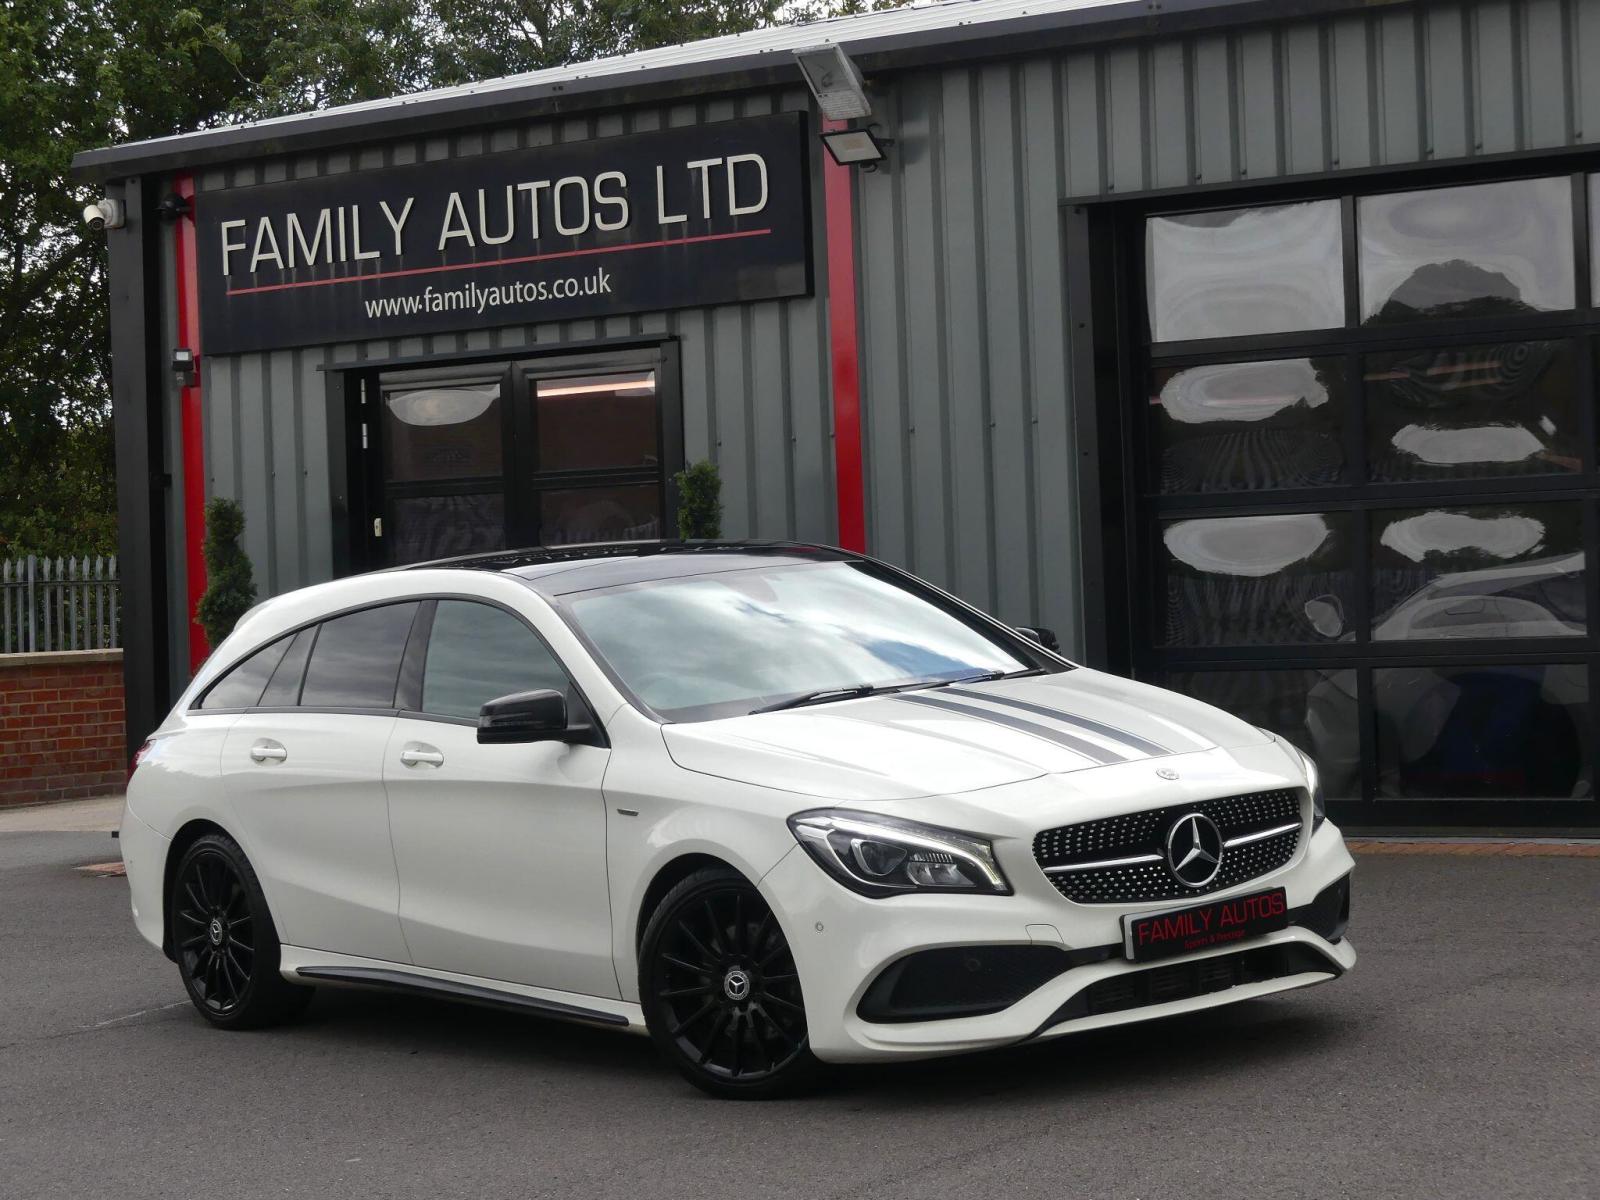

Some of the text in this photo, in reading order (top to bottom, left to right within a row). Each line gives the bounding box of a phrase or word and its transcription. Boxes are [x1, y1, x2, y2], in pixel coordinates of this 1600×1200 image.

[221, 153, 769, 276] FAMILY AUTOS LTD
[365, 267, 612, 319] www.familyautos.co.uk
[1137, 909, 1213, 946] FAMILY
[1220, 892, 1285, 927] AUTOS
